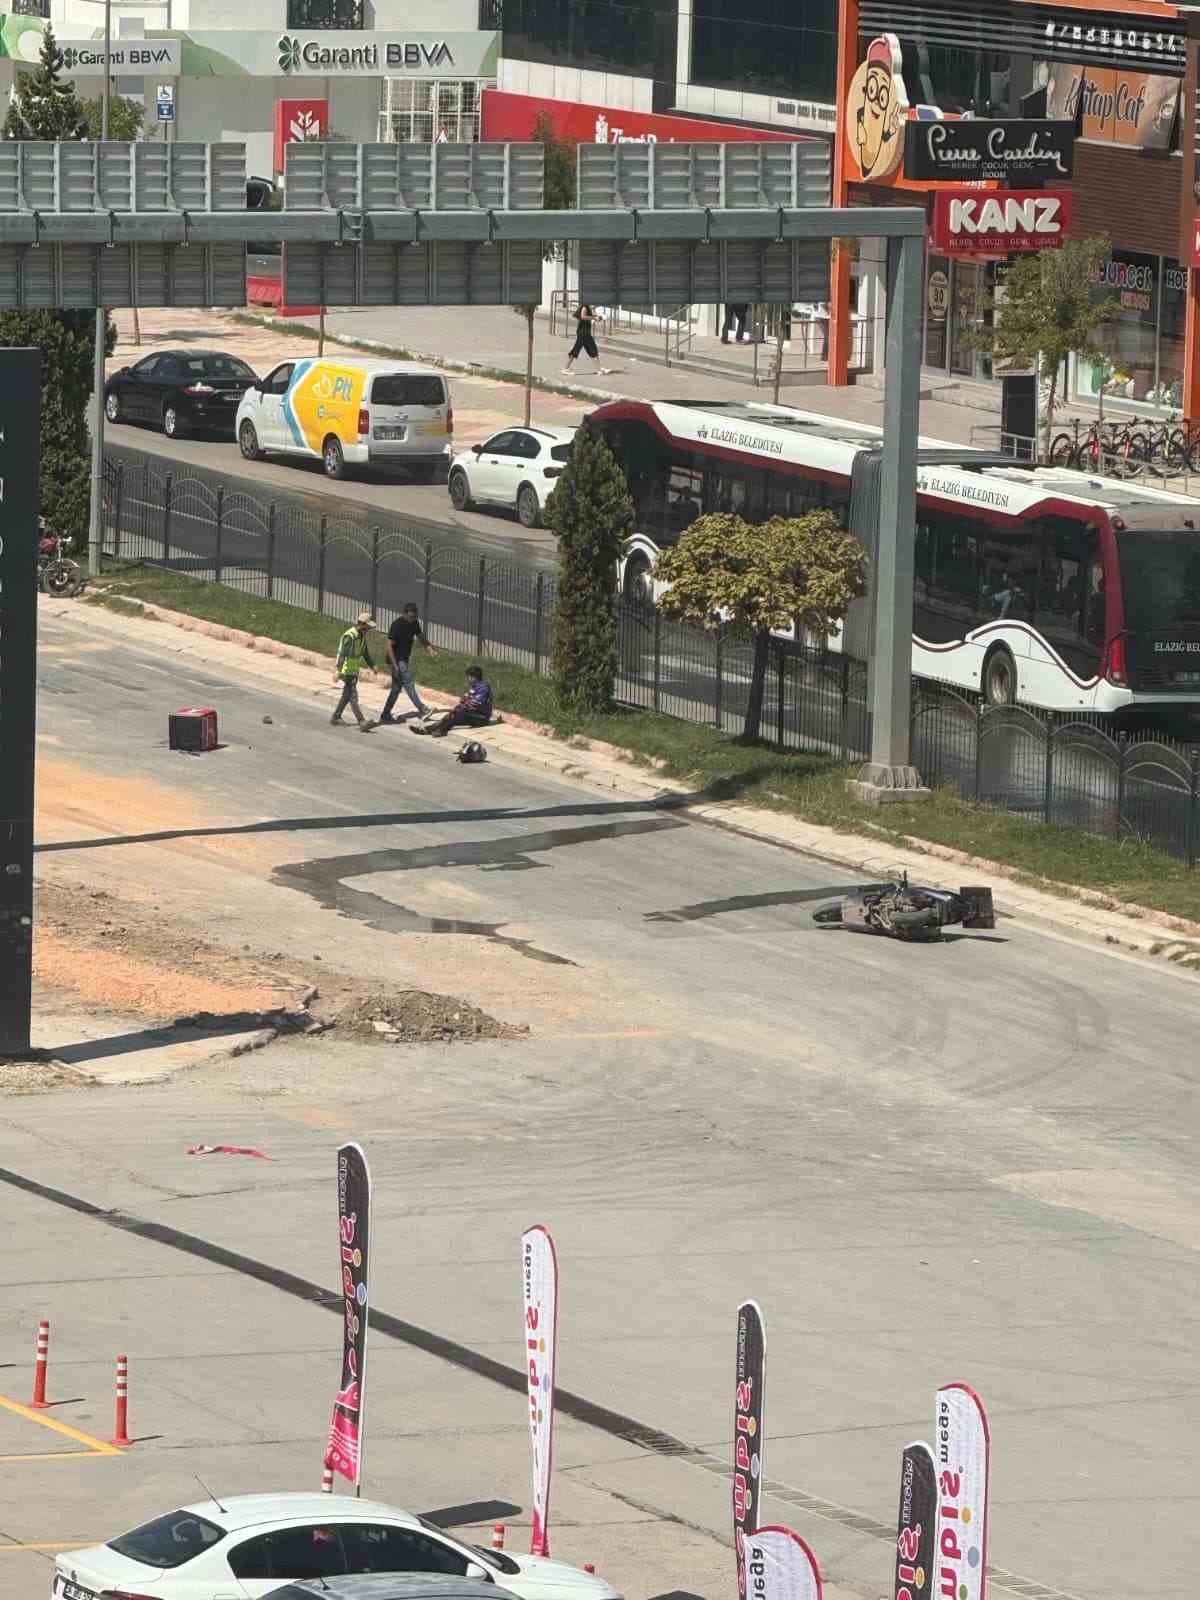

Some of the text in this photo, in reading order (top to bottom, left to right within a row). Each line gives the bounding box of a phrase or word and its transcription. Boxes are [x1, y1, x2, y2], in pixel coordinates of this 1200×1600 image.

[78, 48, 172, 65] Garanti BBVA
[302, 42, 456, 67] Garanti BBVA
[927, 124, 1069, 172] Pierre Cardin
[949, 197, 1061, 234] KANZ
